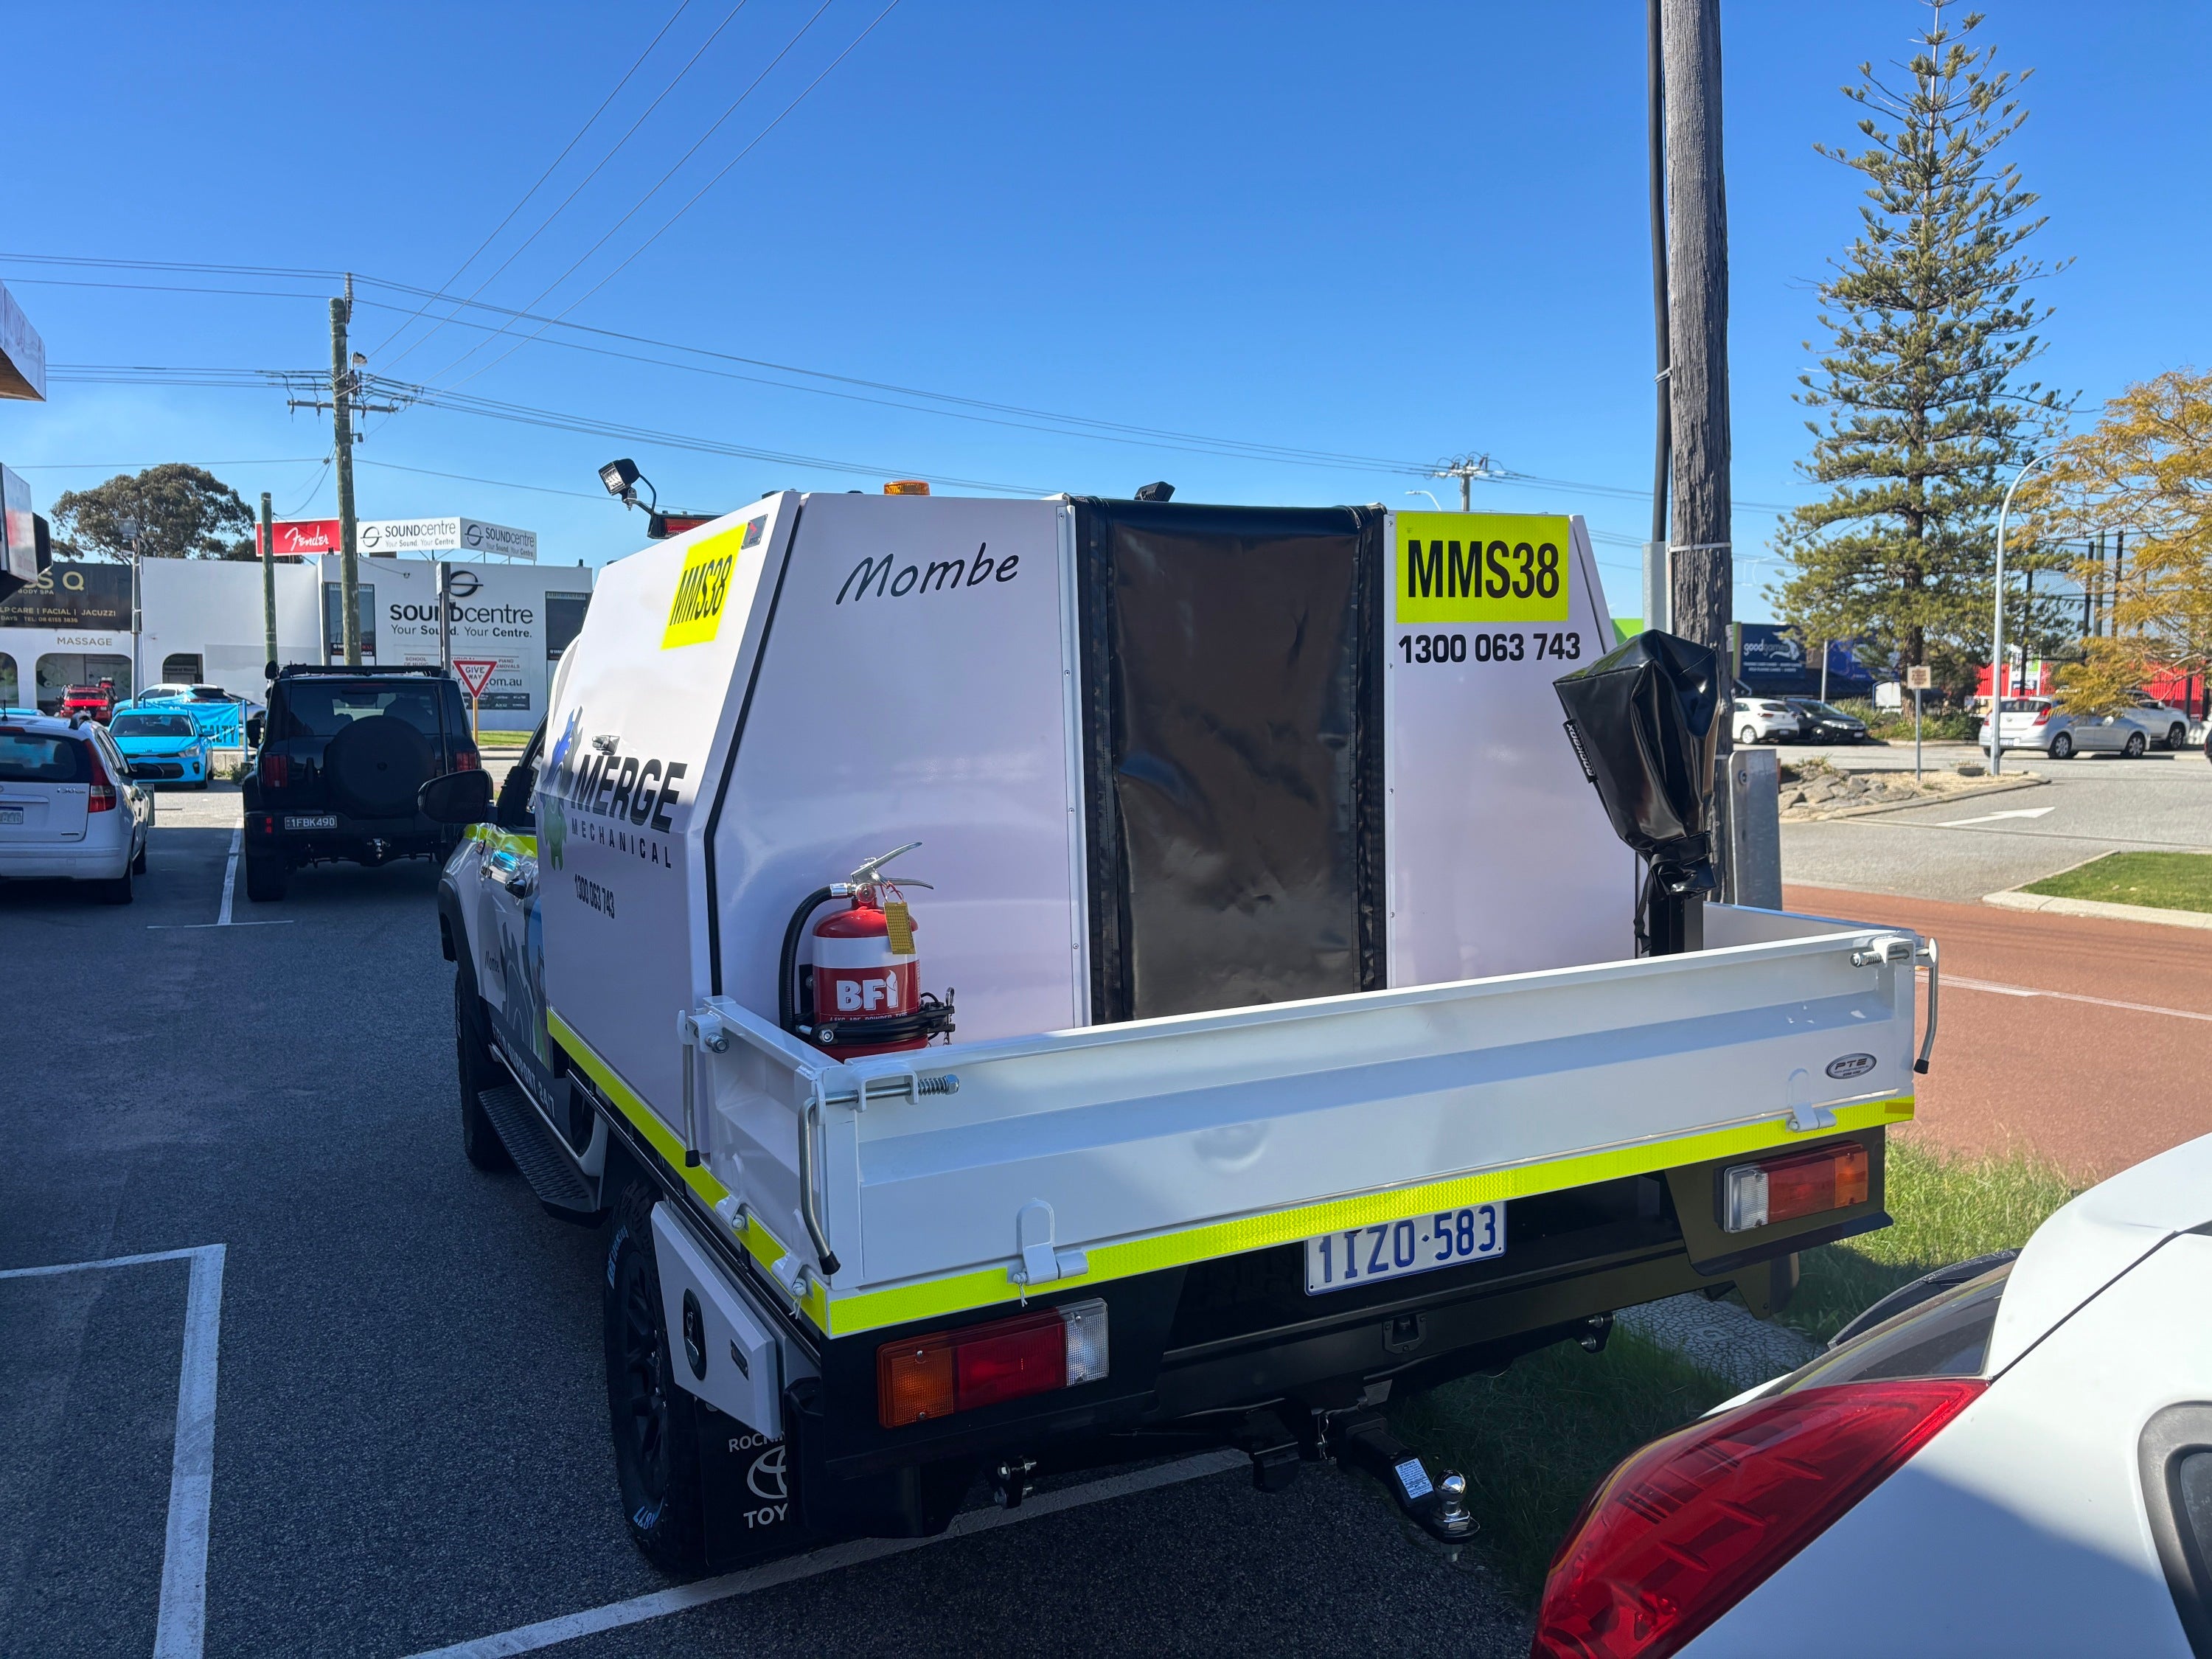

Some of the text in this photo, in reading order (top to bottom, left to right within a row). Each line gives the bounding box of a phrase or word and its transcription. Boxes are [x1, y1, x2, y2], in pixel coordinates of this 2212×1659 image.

[284, 525, 330, 552] Fender
[385, 520, 456, 538] SOUNDcentre
[485, 526, 535, 547] SOUNDcentre
[63, 571, 84, 591] Q
[835, 542, 1019, 605] Mombe
[1408, 540, 1559, 599] MMS38
[669, 554, 732, 626] MMS38
[57, 637, 112, 646] MASSAGE
[391, 625, 532, 638] Your Soud. Your Centre.
[1399, 632, 1580, 664] 1300 063 743
[571, 754, 688, 834] MERGE
[571, 818, 672, 869] MECHANICAL
[574, 873, 615, 919] 1300 063 743
